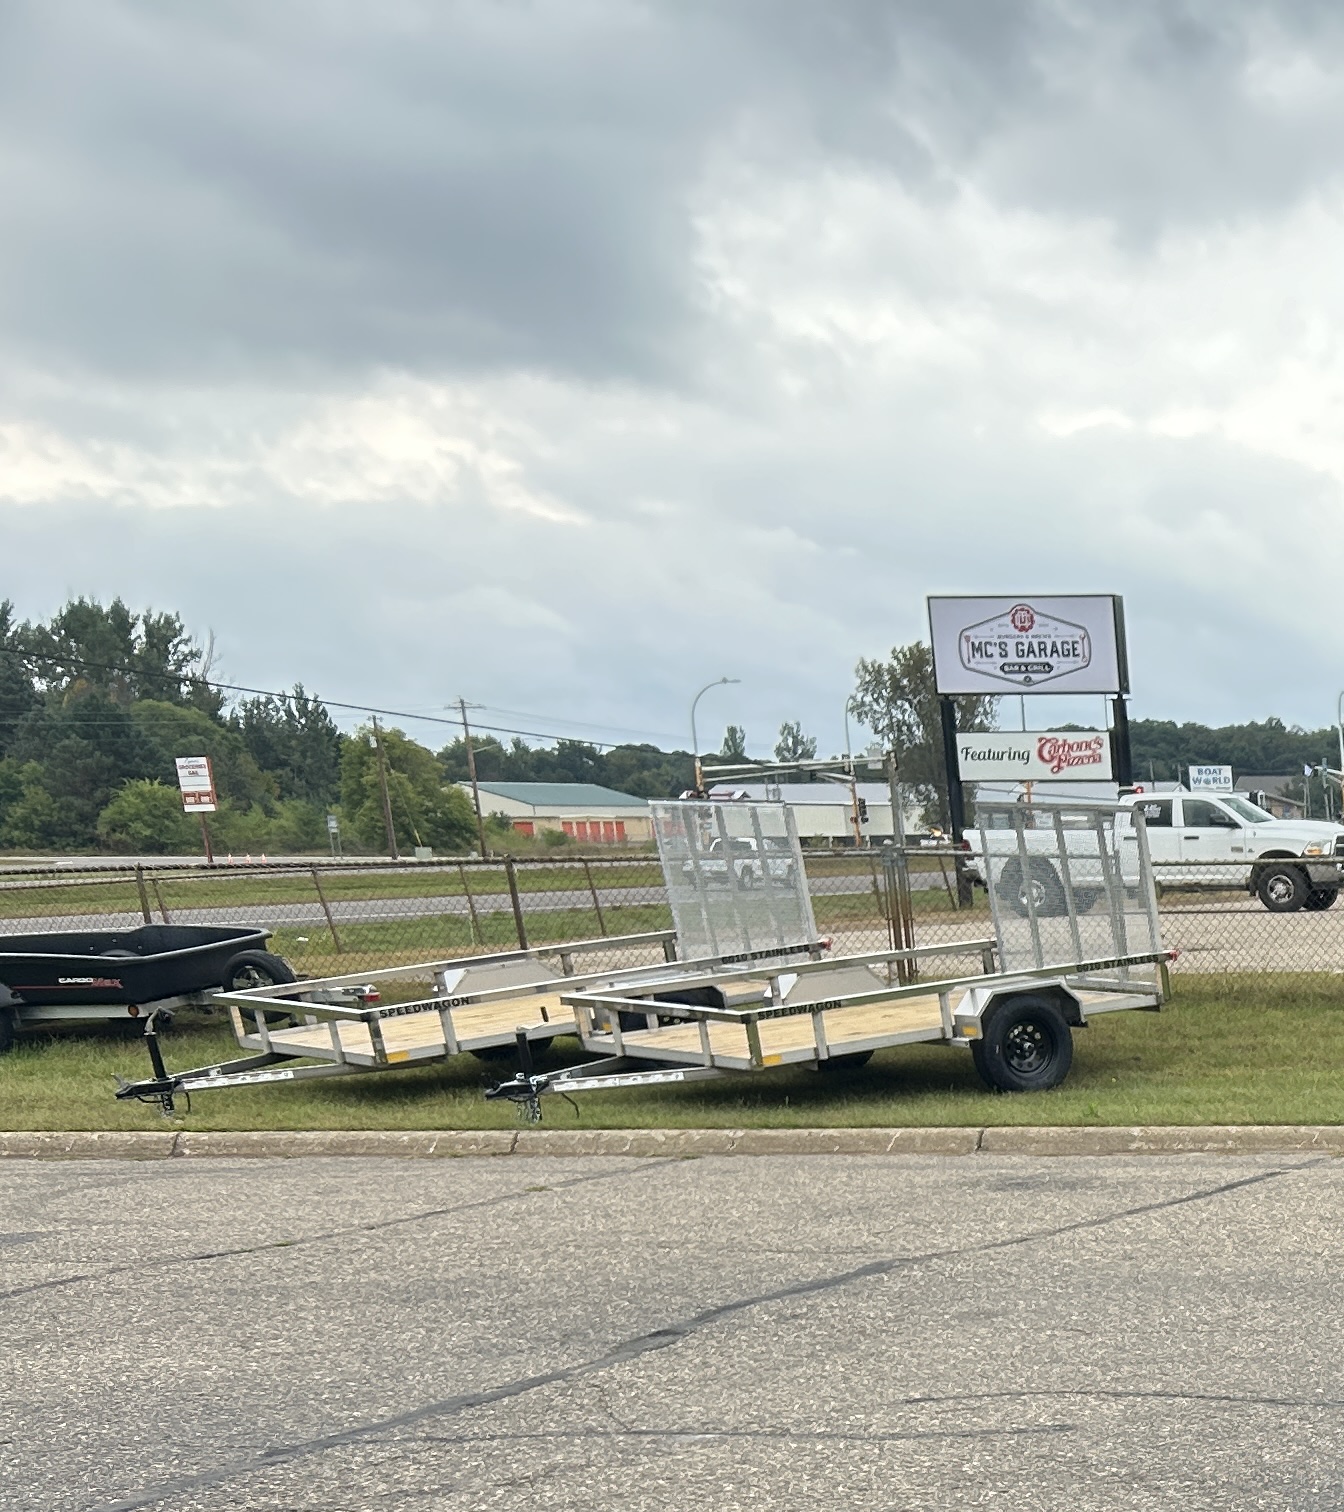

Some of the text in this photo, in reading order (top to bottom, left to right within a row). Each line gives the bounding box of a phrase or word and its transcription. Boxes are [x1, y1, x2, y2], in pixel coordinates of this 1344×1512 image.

[970, 640, 1081, 659] MC'S GARAGE
[960, 746, 1031, 765] Featuring
[1197, 768, 1223, 776] BOAT
[379, 997, 470, 1019] SPEEDWAGON
[757, 1000, 842, 1020] SPEEDWAGON
